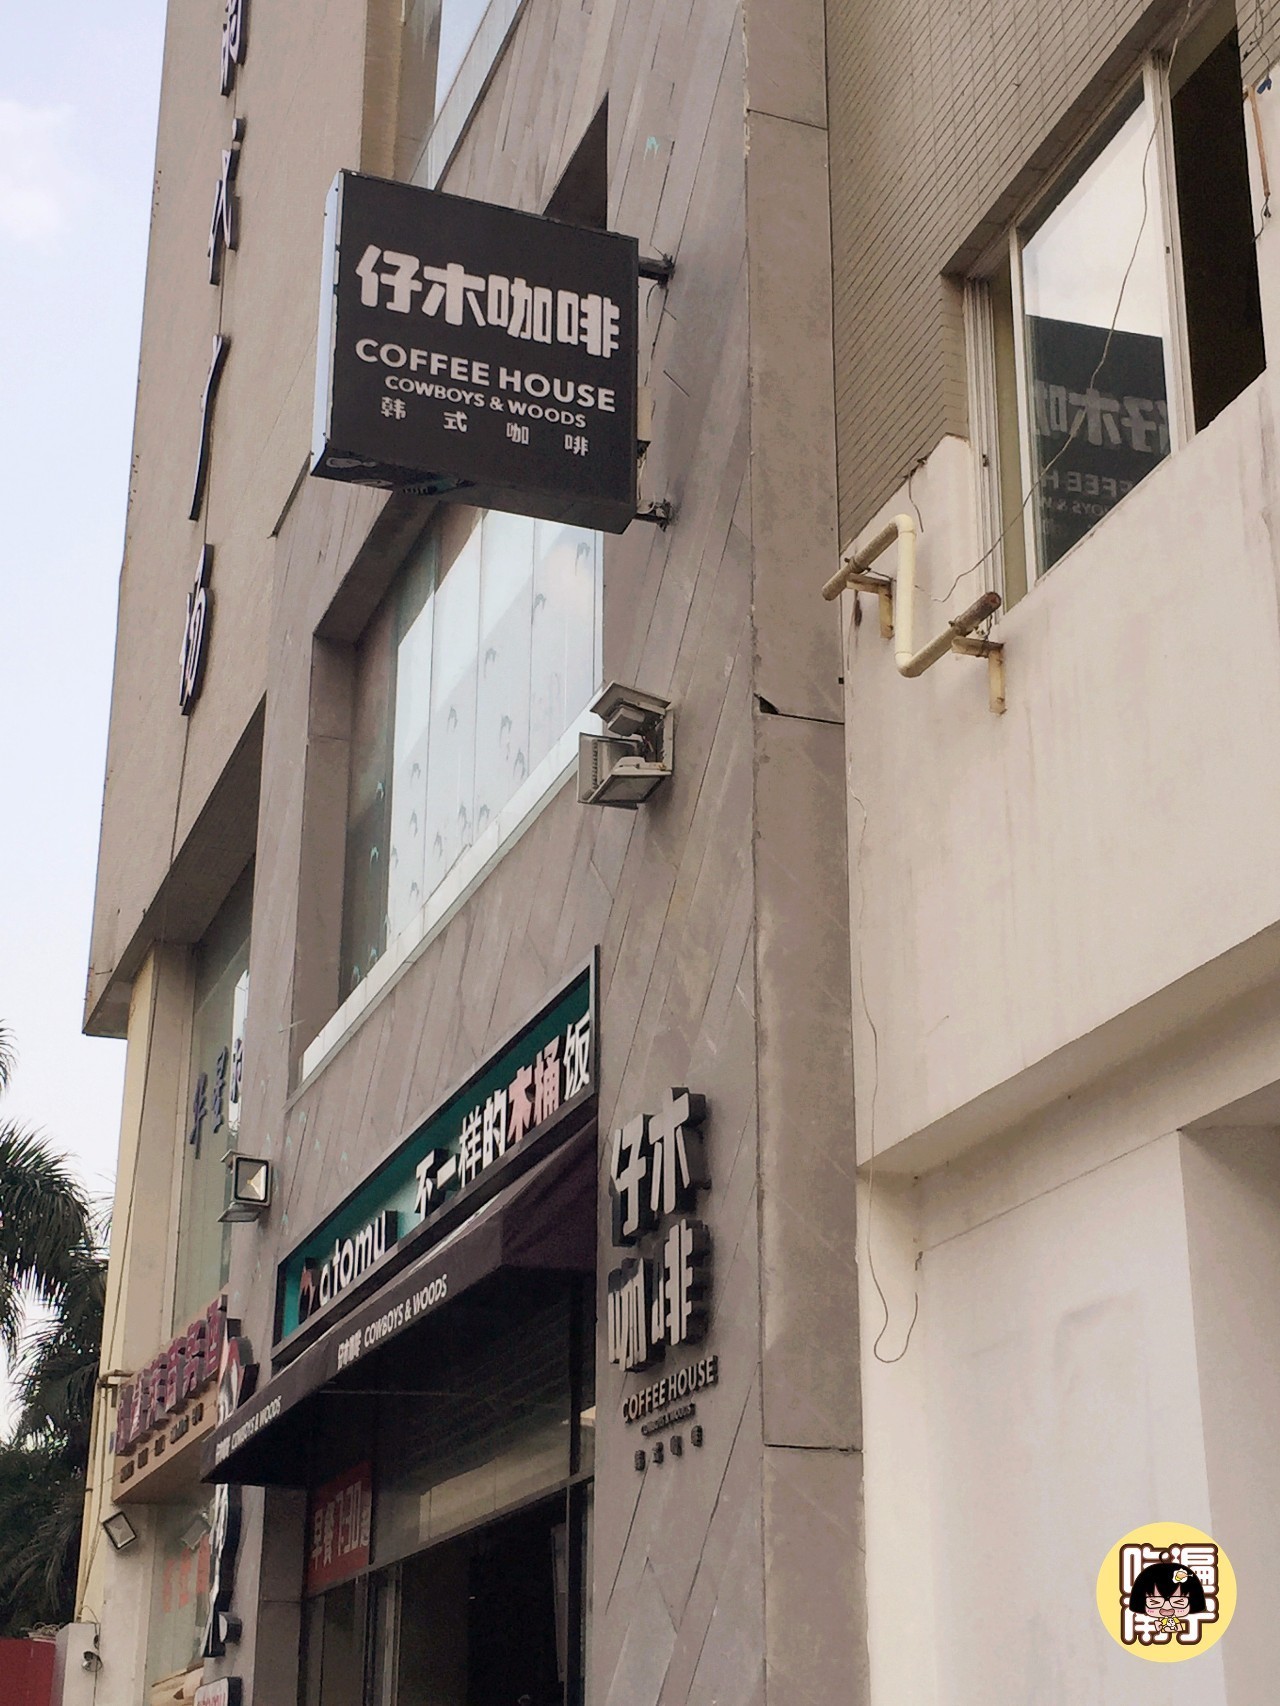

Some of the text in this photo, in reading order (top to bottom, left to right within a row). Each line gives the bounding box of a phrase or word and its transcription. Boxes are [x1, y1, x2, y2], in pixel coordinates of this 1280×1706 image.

[355, 244, 620, 359] 仔木咖啡
[355, 338, 616, 412] COFFEE HOUSE
[385, 375, 587, 428] COWBOYS & WOODS
[381, 395, 589, 457] 韩式咖啡
[414, 1012, 590, 1222] 不一样的木桶饭
[364, 1303, 404, 1347] COWBOYS
[413, 1273, 448, 1315] WOODS
[608, 1219, 693, 1371] 咖啡
[622, 1379, 666, 1424] COFFEE
[668, 1356, 715, 1401] HOUSE
